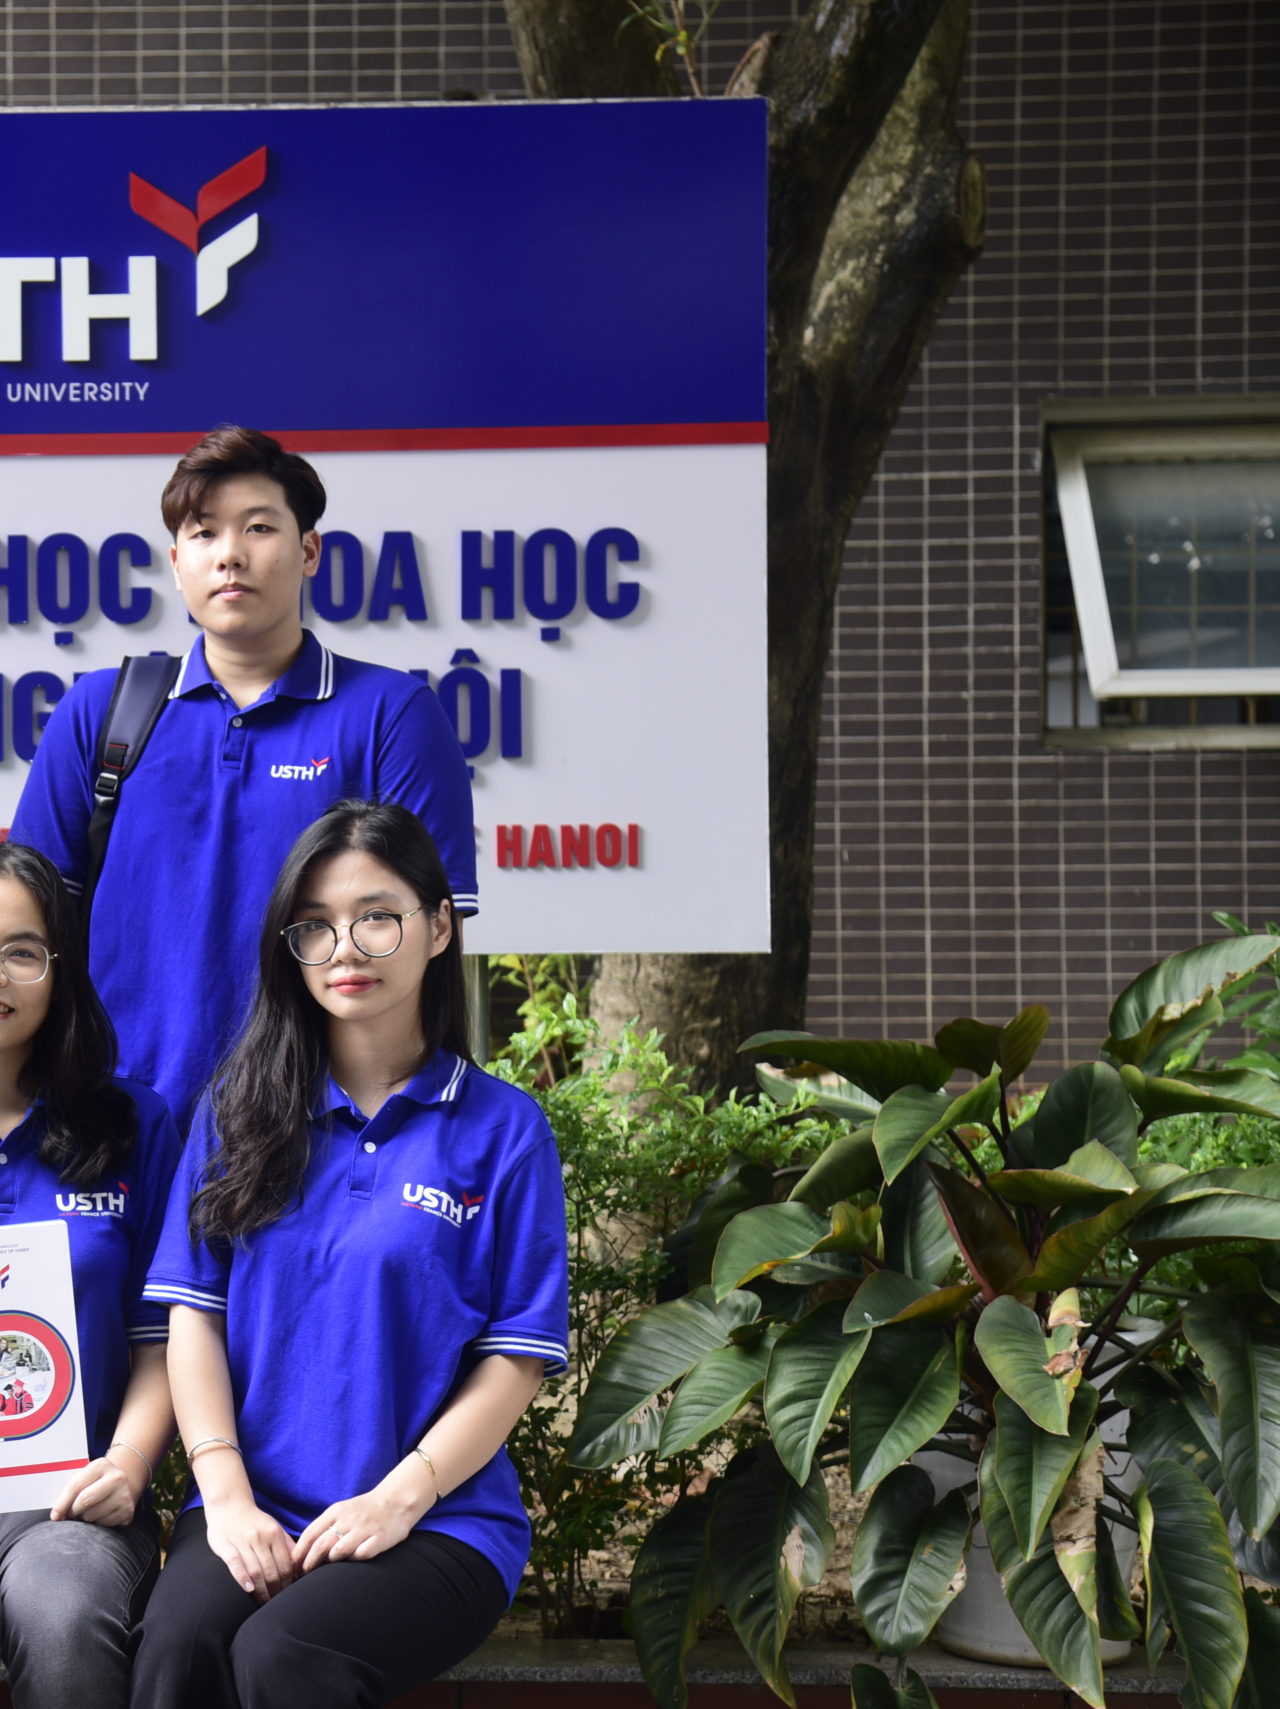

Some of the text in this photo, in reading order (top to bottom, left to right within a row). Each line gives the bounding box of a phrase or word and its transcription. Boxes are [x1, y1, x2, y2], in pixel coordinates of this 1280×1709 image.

[6, 381, 150, 402] UNIVERSITY
[461, 526, 641, 642] HỌC
[409, 647, 523, 780] ỘI
[270, 764, 315, 781] USTH
[496, 823, 640, 868] HANOI
[55, 1192, 125, 1213] USTH
[403, 1183, 464, 1224] USTH
